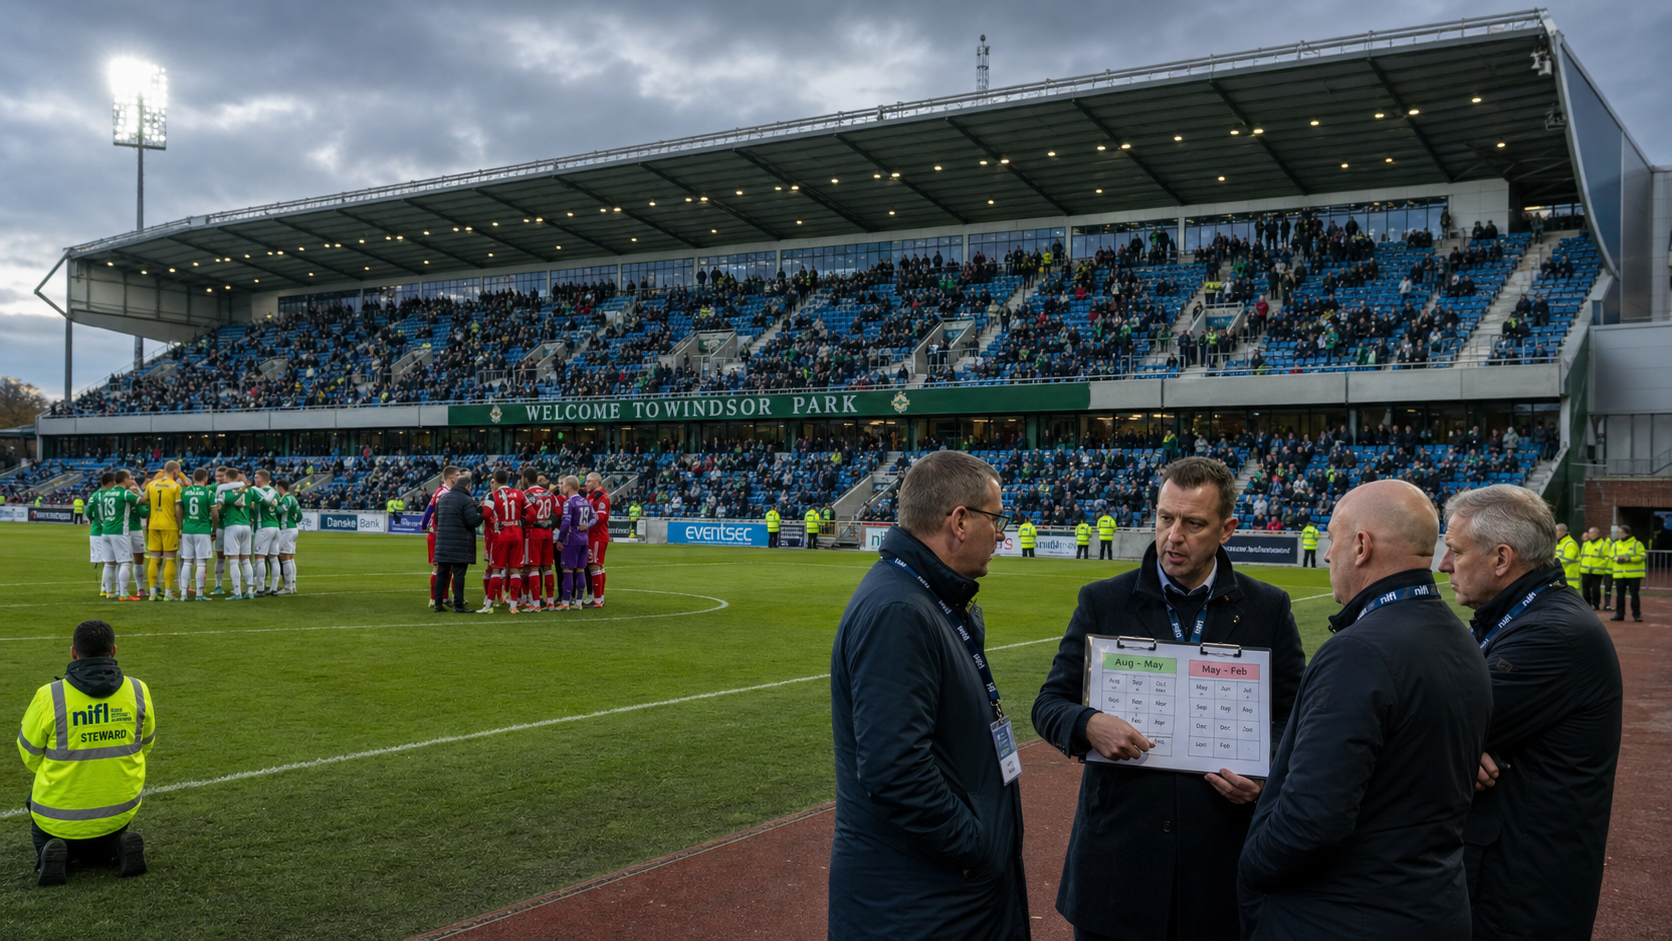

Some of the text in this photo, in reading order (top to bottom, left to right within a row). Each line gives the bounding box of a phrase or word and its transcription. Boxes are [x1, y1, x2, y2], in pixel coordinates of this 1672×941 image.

[525, 395, 858, 421] WELCOME TO WINDSOR PARK
[157, 490, 162, 507] 1
[189, 496, 199, 516] 6
[502, 500, 516, 520] 11
[536, 499, 551, 520] 20
[327, 517, 356, 528] Danske
[360, 518, 380, 529] Bank
[685, 523, 752, 541] eventsec
[1115, 658, 1134, 669] Aug
[1144, 660, 1164, 670] May
[1202, 665, 1221, 675] May
[1231, 667, 1247, 676] Feb
[72, 703, 109, 726] nifl
[80, 729, 127, 743] STEWARD
